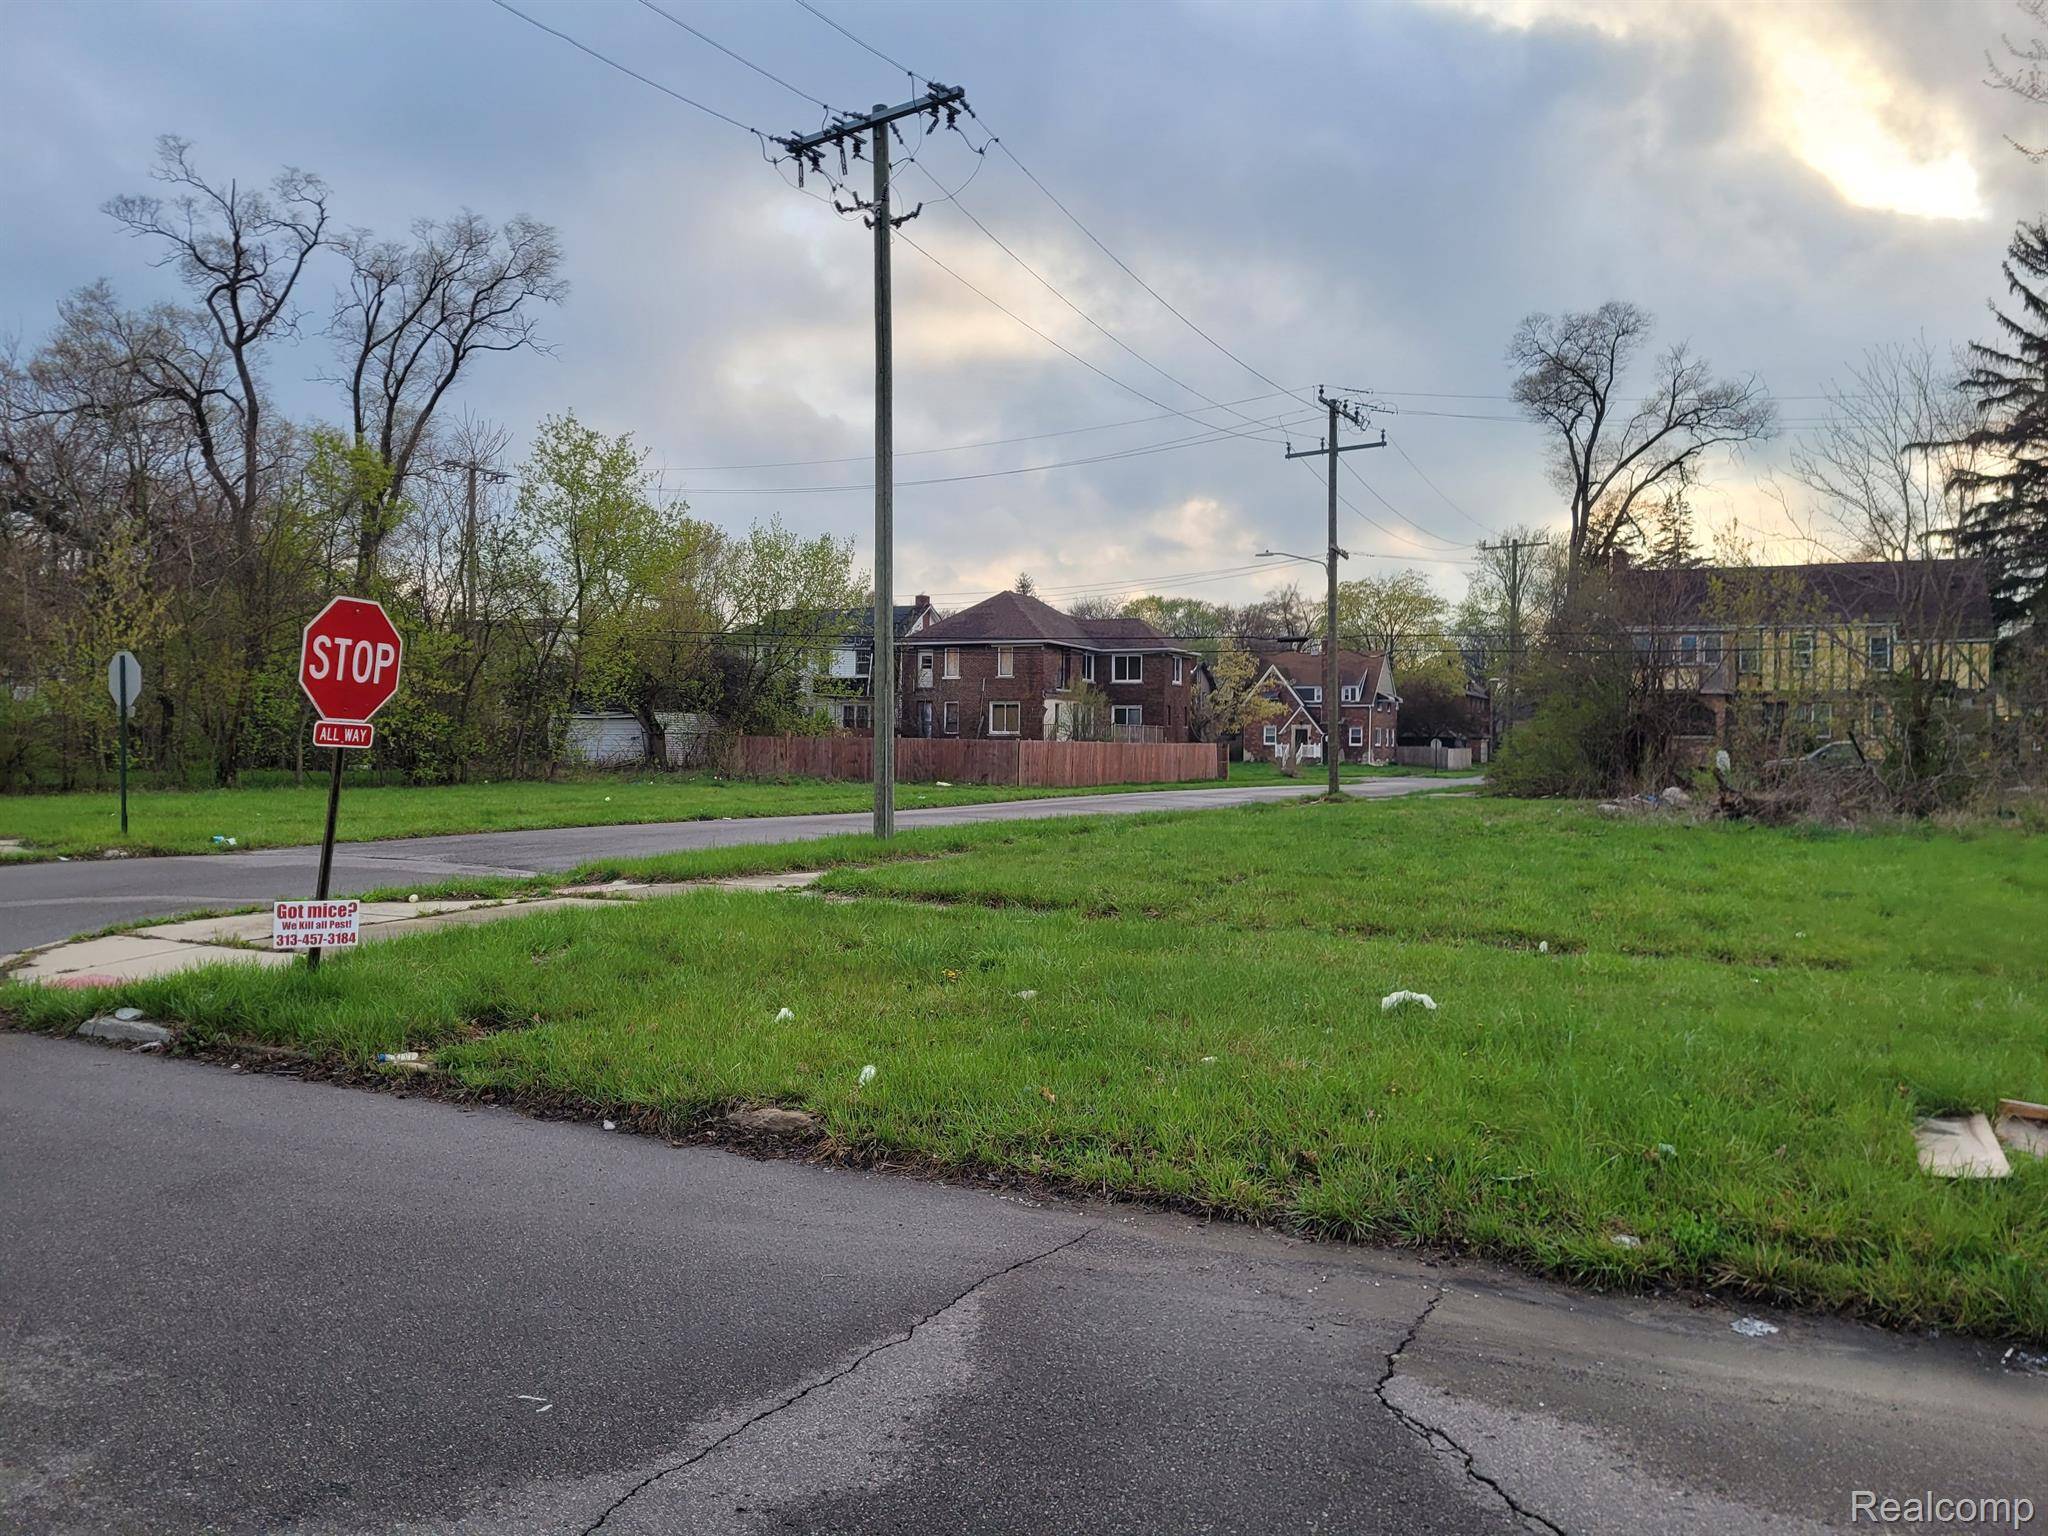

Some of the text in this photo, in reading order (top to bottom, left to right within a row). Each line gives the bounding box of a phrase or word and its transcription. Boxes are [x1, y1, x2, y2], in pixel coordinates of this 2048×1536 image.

[309, 635, 395, 684] STOP
[320, 727, 367, 742] ALL WAY
[277, 902, 358, 919] Got mice?
[282, 920, 352, 930] We Kill all Pest!
[276, 932, 356, 946] 313-457-3184
